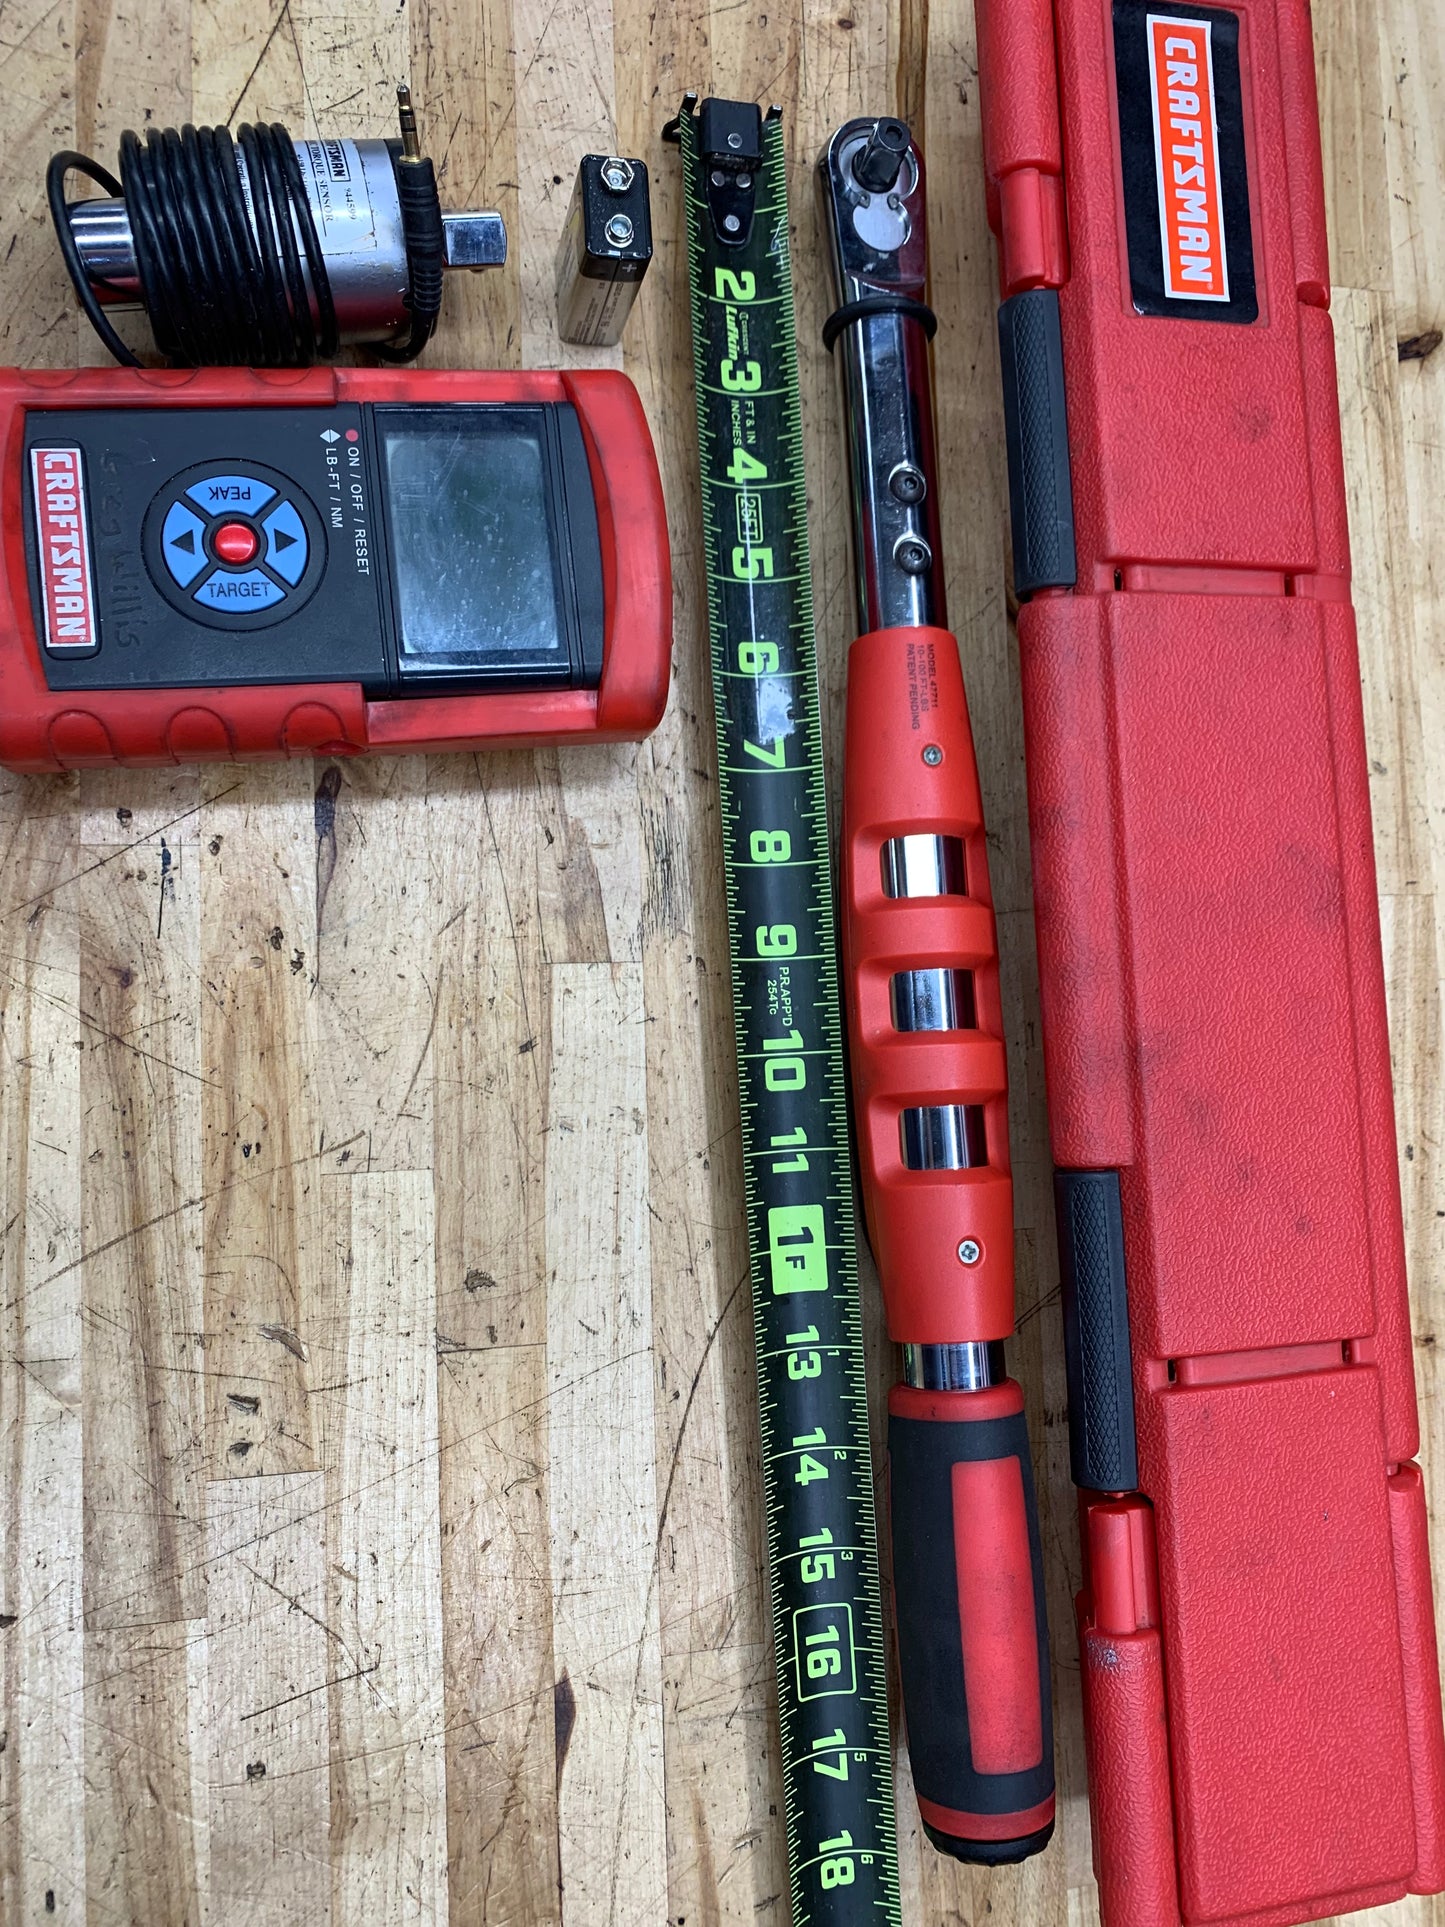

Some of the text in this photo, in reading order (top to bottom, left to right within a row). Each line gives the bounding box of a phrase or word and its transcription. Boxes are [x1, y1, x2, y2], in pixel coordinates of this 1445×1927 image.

[310, 146, 326, 176] TORQUE
[1165, 37, 1212, 282] CRAFTSMAN
[715, 267, 756, 300] 2
[726, 304, 741, 360] Lufkin
[740, 320, 749, 356] CRESCENT
[720, 359, 762, 391] 3
[731, 399, 742, 446] INCHES
[744, 400, 756, 444] FT & IN
[325, 447, 341, 491] LB-FT
[347, 446, 361, 466] ON
[727, 448, 768, 482] 4
[208, 486, 251, 500] PEAK
[350, 483, 363, 512] OFF
[330, 507, 344, 528] NM
[741, 498, 758, 539] 25FT
[43, 452, 87, 637] CRAFTSMAN
[354, 529, 370, 576] RESET
[732, 547, 774, 578] 5
[206, 582, 270, 598] TARGET
[738, 641, 779, 673] 6
[927, 643, 937, 678] MODEL
[906, 643, 920, 730] PATENT PENDING
[917, 645, 930, 712] 10-100 FT-LBS
[744, 737, 786, 768] 7
[750, 830, 791, 863] 8
[756, 924, 798, 956] 9
[763, 1029, 806, 1092] 10
[770, 1127, 809, 1174] 11
[786, 1325, 822, 1380] 13
[792, 1427, 829, 1486] 14
[834, 1450, 847, 1461] 2
[799, 1527, 836, 1584] 15
[840, 1551, 854, 1561] 3
[805, 1625, 842, 1679] 16
[812, 1728, 849, 1781] 17
[854, 1752, 867, 1762] 5
[818, 1829, 855, 1890] 18
[860, 1854, 874, 1864] 6
